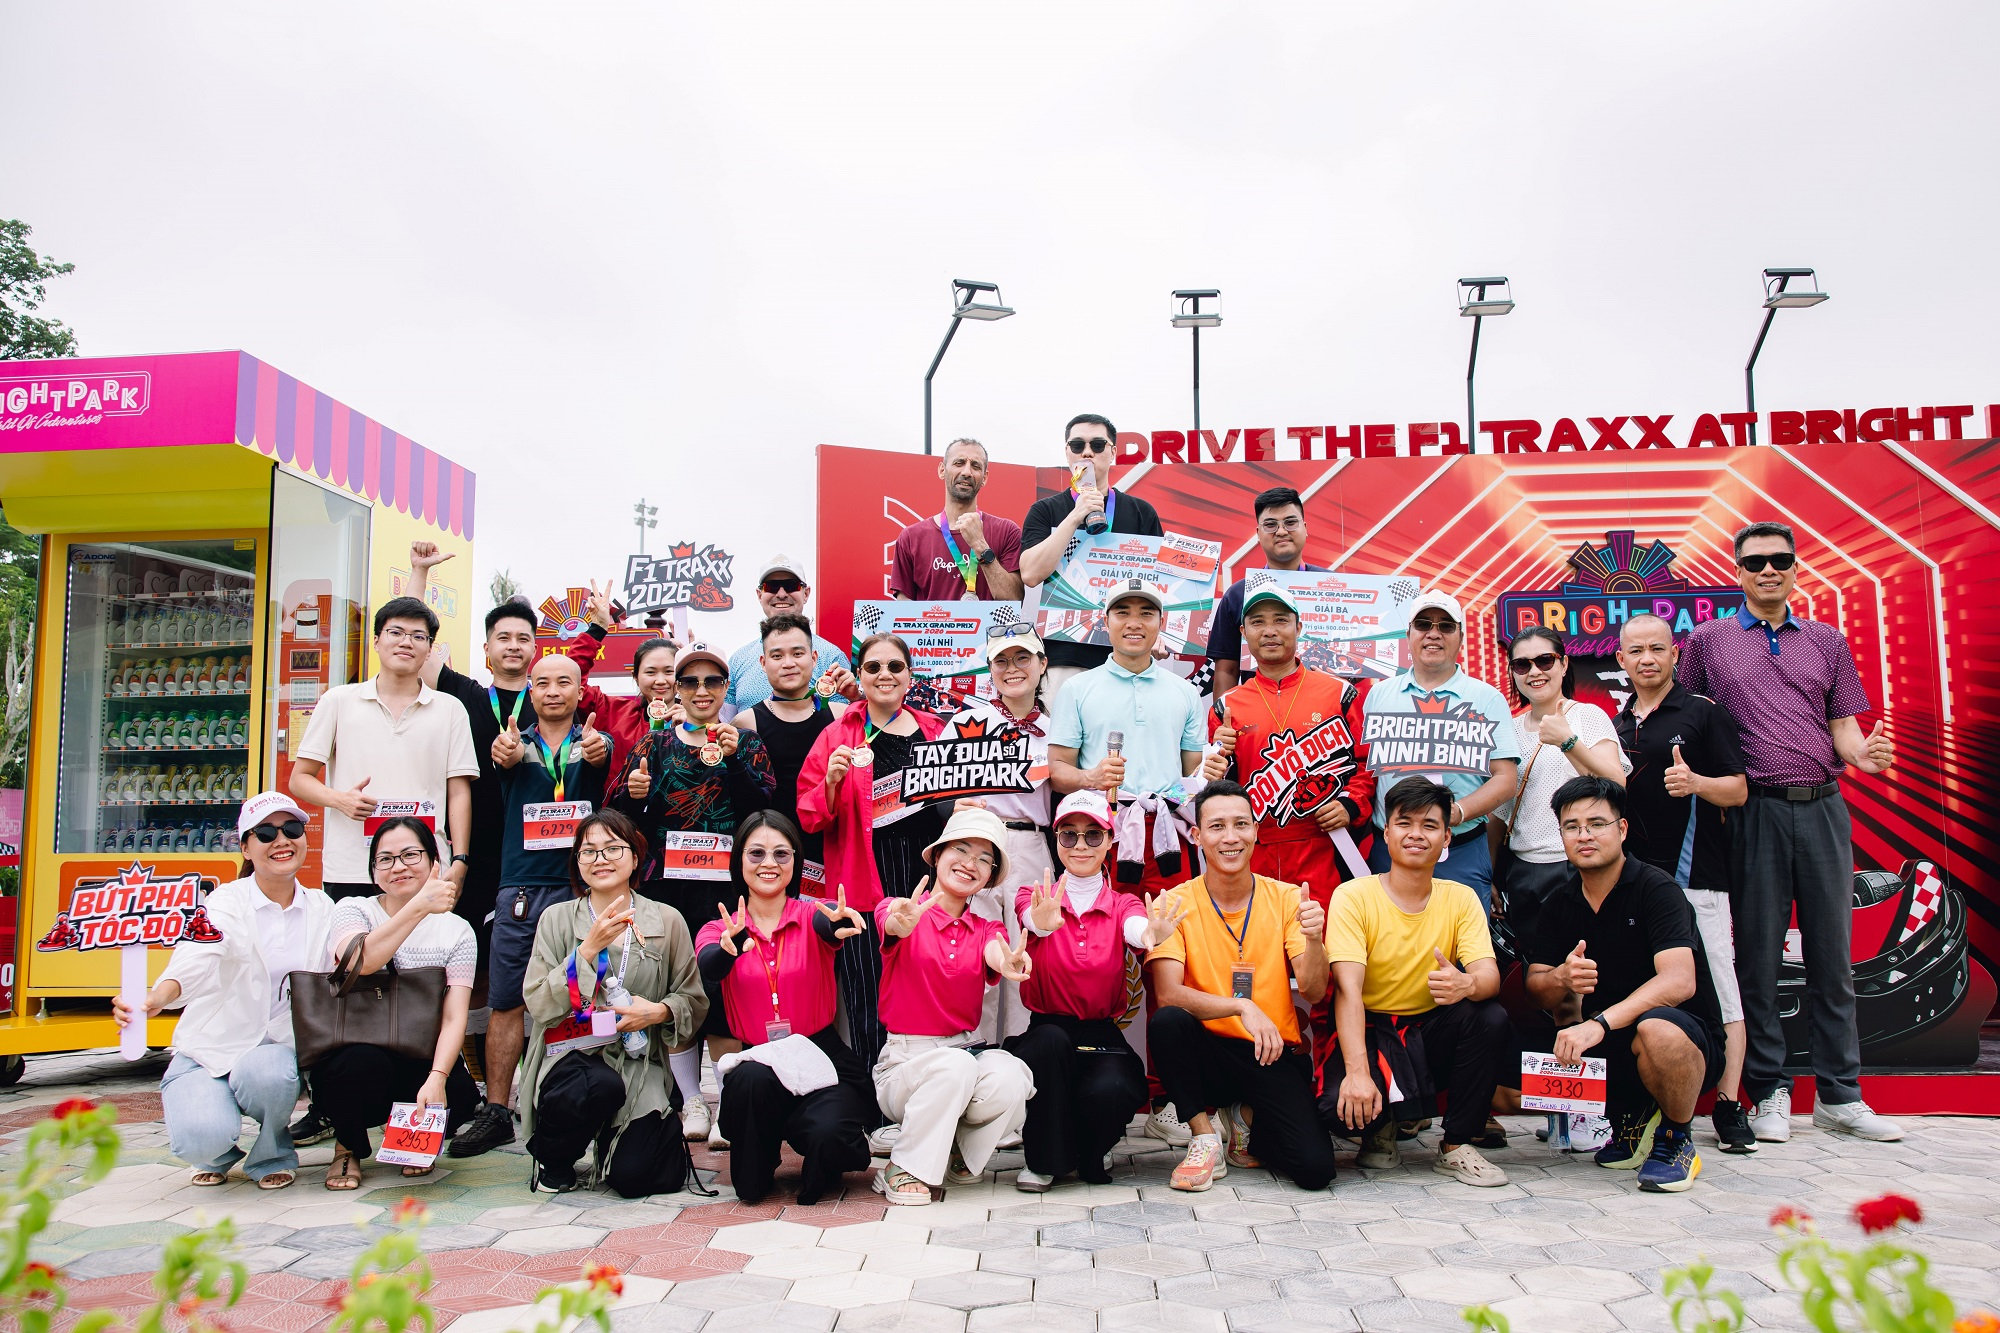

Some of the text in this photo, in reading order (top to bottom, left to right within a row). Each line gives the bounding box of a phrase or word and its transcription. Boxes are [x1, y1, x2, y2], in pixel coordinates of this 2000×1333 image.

[1116, 428, 1276, 464] DRIVE
[1287, 424, 1396, 460] THE
[1408, 421, 1470, 457] F1
[1480, 415, 1676, 455] TRAXX
[1688, 411, 1758, 448] AT
[1767, 405, 1974, 446] BRIGHT
[628, 547, 731, 585] F1 TRAXX
[1125, 555, 1152, 563] GRAND
[1100, 568, 1119, 577] GIẢI
[1122, 569, 1133, 579] VÔ
[630, 581, 695, 611] 2026
[1298, 613, 1379, 625] HIRD PLACE
[1336, 606, 1348, 614] BA
[909, 647, 976, 658] UNNER-UP
[917, 638, 953, 647] GIẢI NHÌ
[1365, 715, 1496, 748] BRIGHTPARK
[914, 738, 1028, 767] TAY ĐUA SỐ 1
[1371, 741, 1490, 773] NINH BÌNH
[1247, 721, 1351, 817] ĐỘI VÔ ĐỊCH
[540, 823, 574, 836] 6229
[683, 853, 714, 866] 6091
[136, 878, 195, 910] PHÁ
[84, 911, 184, 946] TỐC ĐỘ
[1540, 1077, 1584, 1099] 3930
[396, 1130, 431, 1151] 2953
